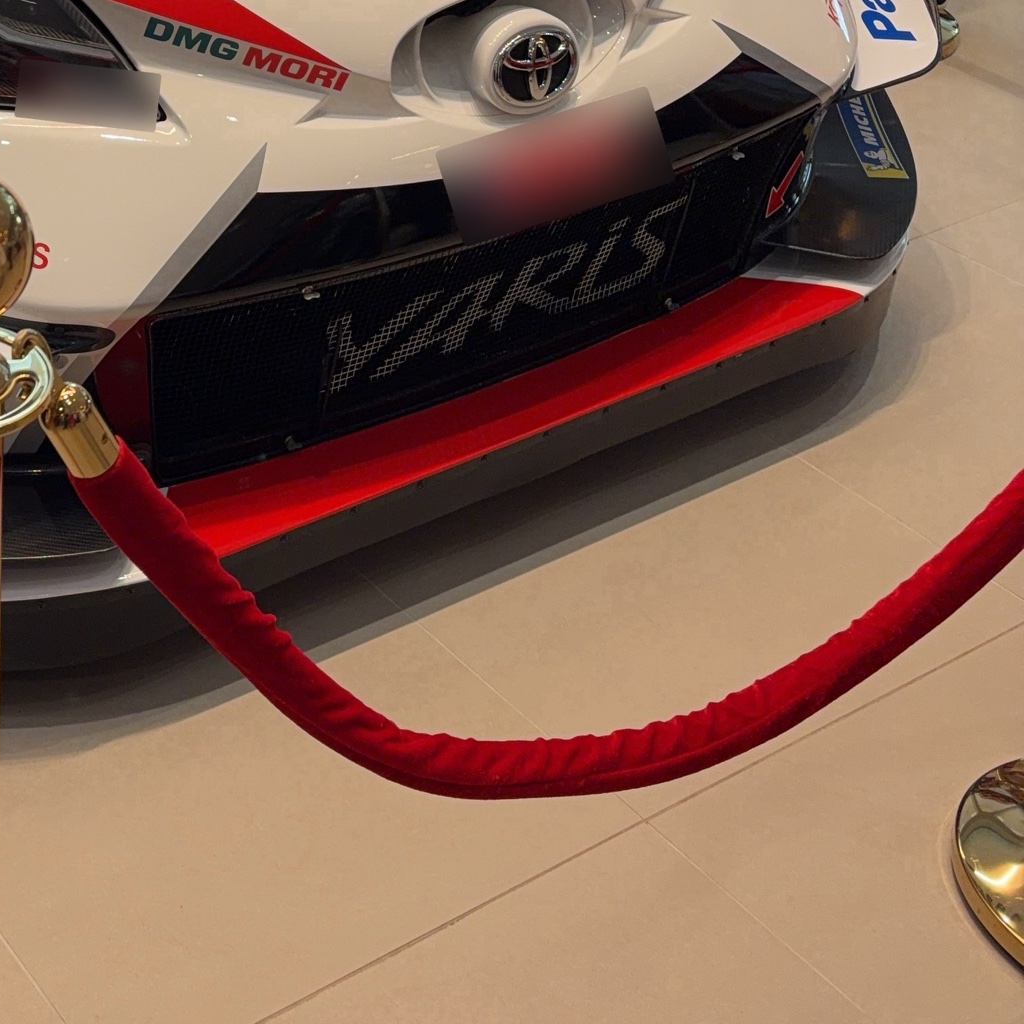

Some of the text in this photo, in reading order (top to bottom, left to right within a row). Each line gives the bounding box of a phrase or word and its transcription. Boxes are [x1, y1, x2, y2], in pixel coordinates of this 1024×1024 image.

[143, 16, 351, 92] DMG MORI
[326, 194, 687, 393] YARIS
